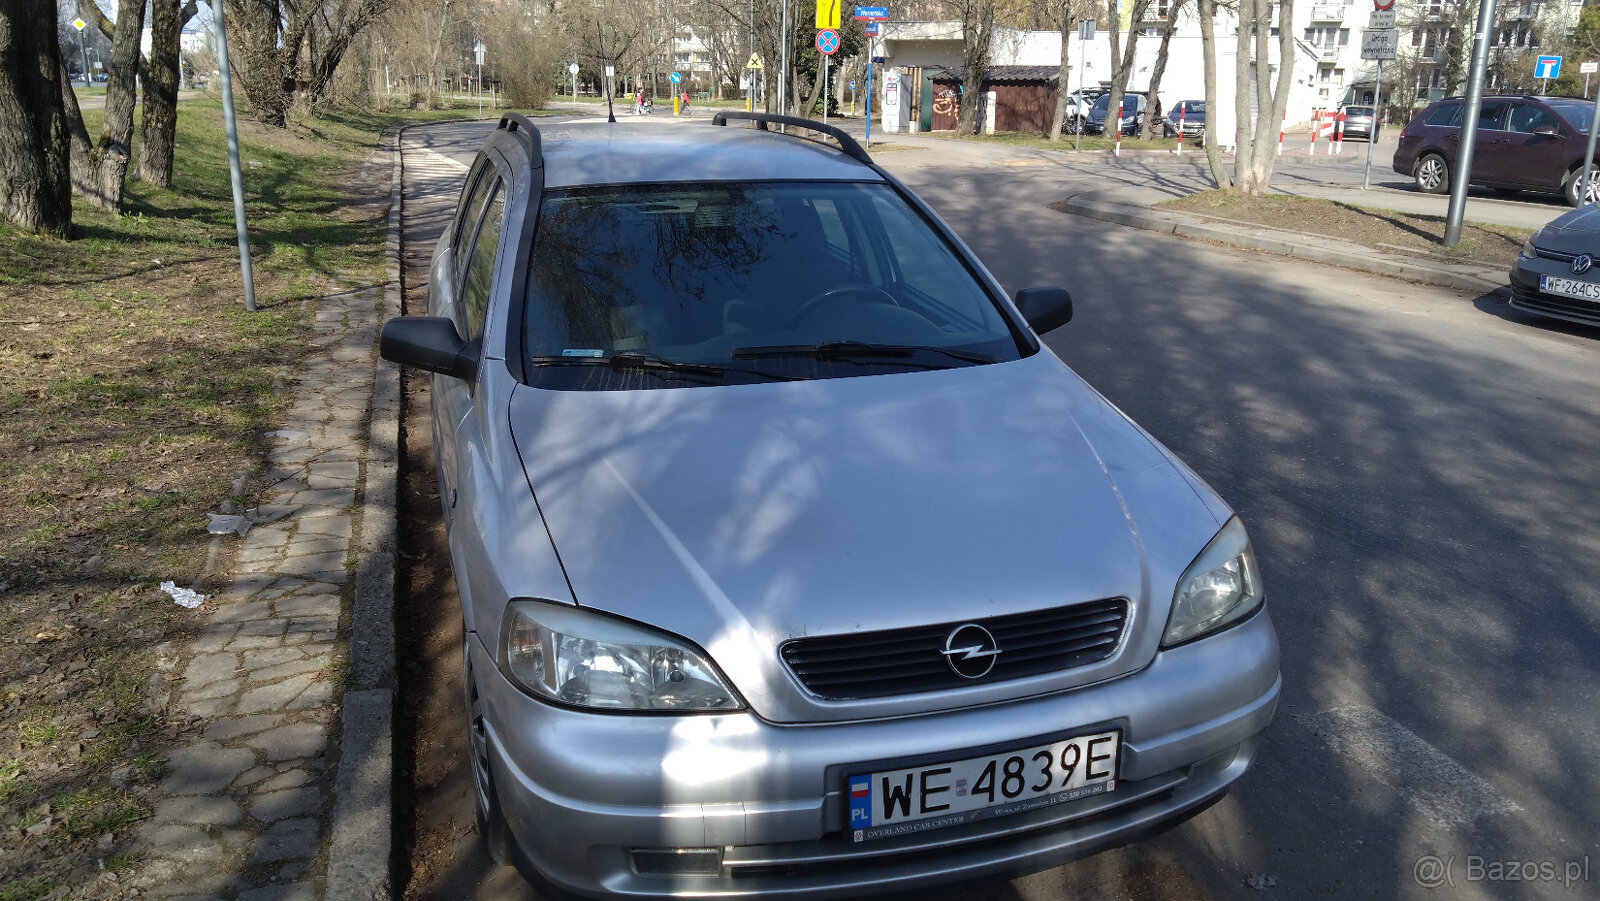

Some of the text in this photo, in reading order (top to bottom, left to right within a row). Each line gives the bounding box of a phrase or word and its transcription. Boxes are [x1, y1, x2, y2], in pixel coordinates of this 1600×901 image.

[1548, 277, 1600, 298] WF 264CS
[881, 736, 1113, 820] WE 4839E
[851, 808, 869, 822] PL
[867, 816, 965, 838] OVERLAND CAR CENTER
